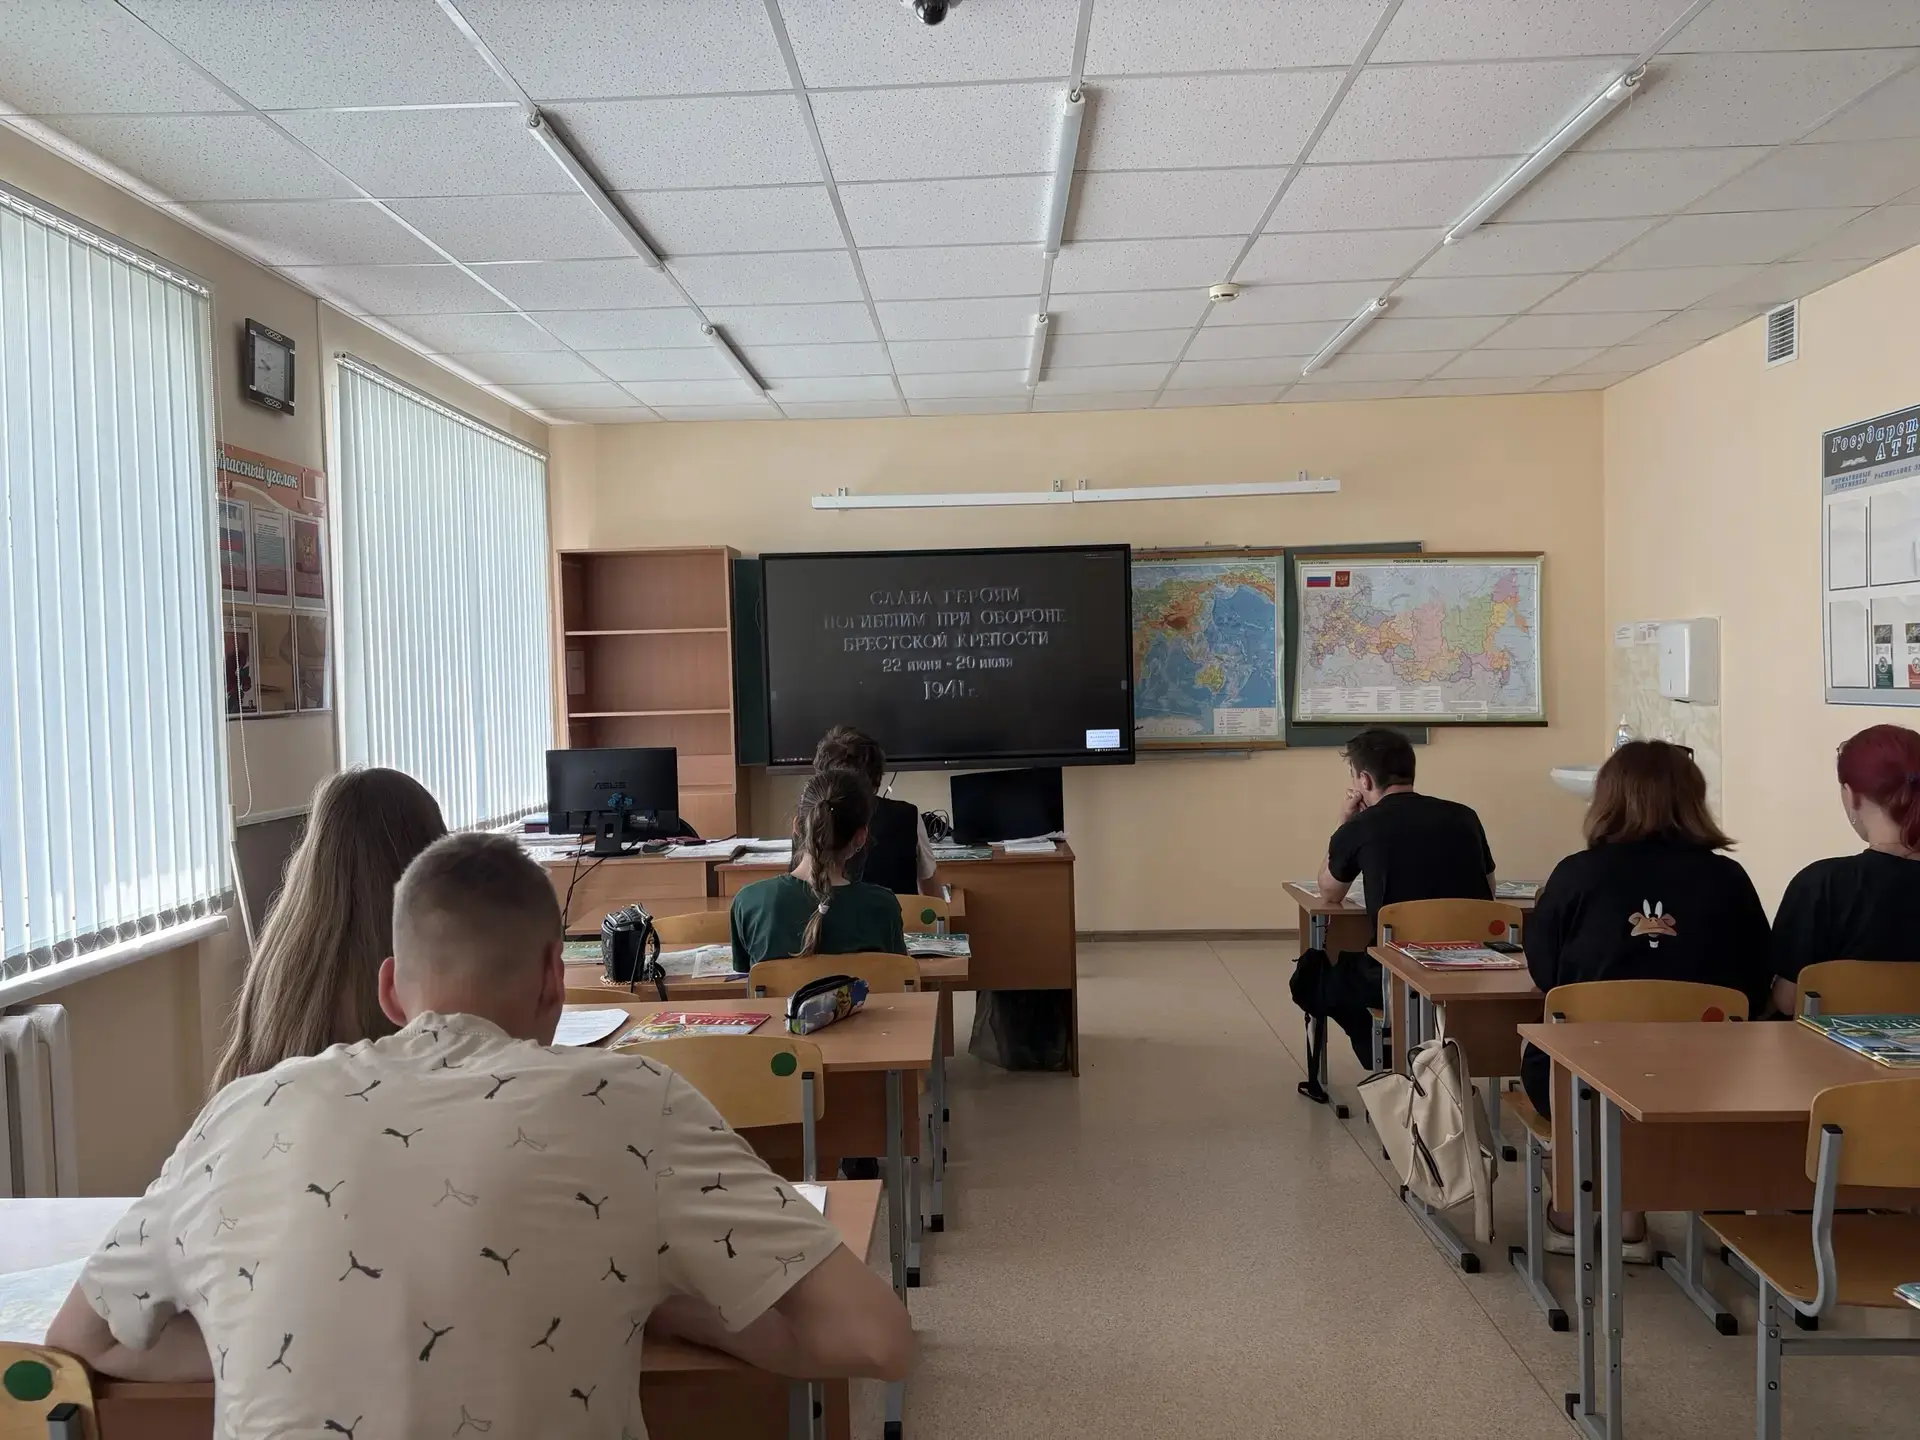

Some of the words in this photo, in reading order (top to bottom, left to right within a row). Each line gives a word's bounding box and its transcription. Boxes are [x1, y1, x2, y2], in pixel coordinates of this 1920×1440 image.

[265, 467, 298, 489] уголок
[869, 589, 933, 605] СЛАВА
[942, 587, 1020, 604] ГЕРОЯМ
[824, 612, 926, 629] ПОГИБШИМ
[936, 611, 970, 627] ПРИ
[980, 607, 1066, 625] ОБОРОНЕ
[843, 631, 949, 652] БРЕСТСКОЙ
[956, 630, 1050, 649] КРЕПОСТИ
[882, 657, 902, 673] 22
[907, 659, 942, 672] июня
[955, 655, 976, 670] 20
[979, 657, 1013, 669] июля
[923, 679, 965, 700] 1941
[593, 781, 628, 790] ASUS
